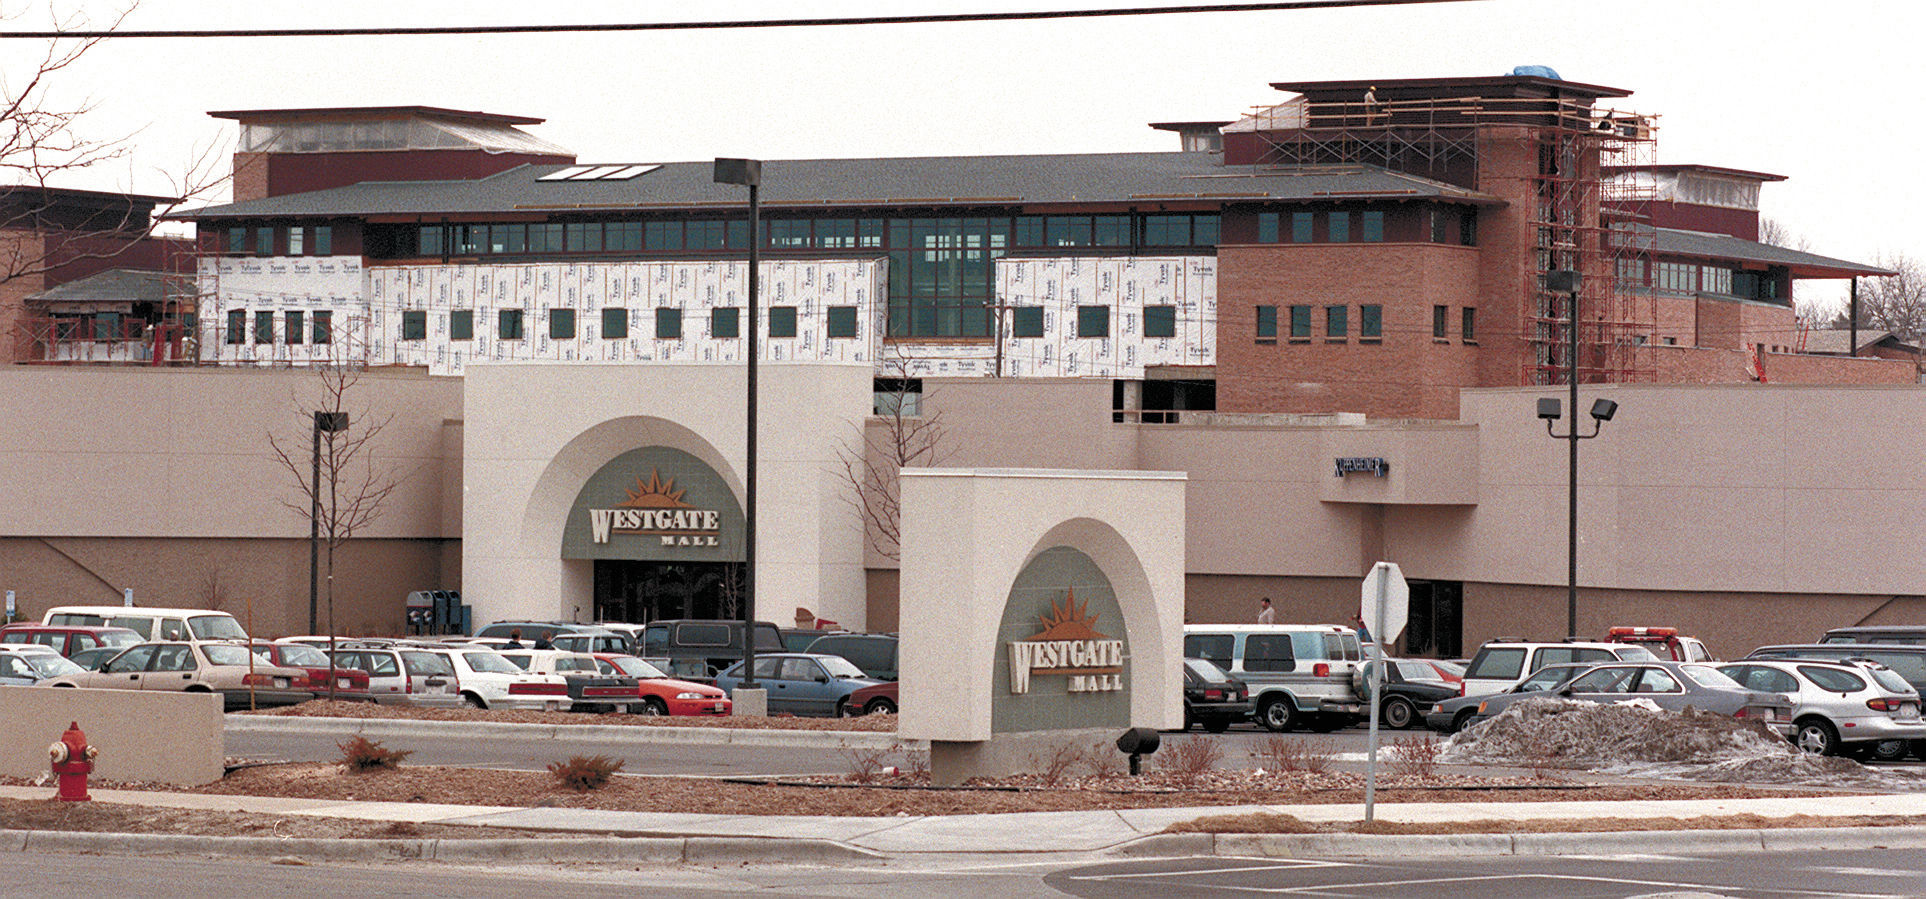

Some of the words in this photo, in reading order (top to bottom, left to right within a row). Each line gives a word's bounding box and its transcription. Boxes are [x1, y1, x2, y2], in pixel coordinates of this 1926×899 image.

[294, 264, 310, 272] Tyvek
[319, 264, 335, 272] Tyvek
[1177, 300, 1196, 308] Tyvek
[589, 509, 719, 544] WESTGATE
[661, 535, 719, 546] MALL
[1007, 640, 1123, 694] WESTGATE
[1067, 674, 1123, 694] MALL
